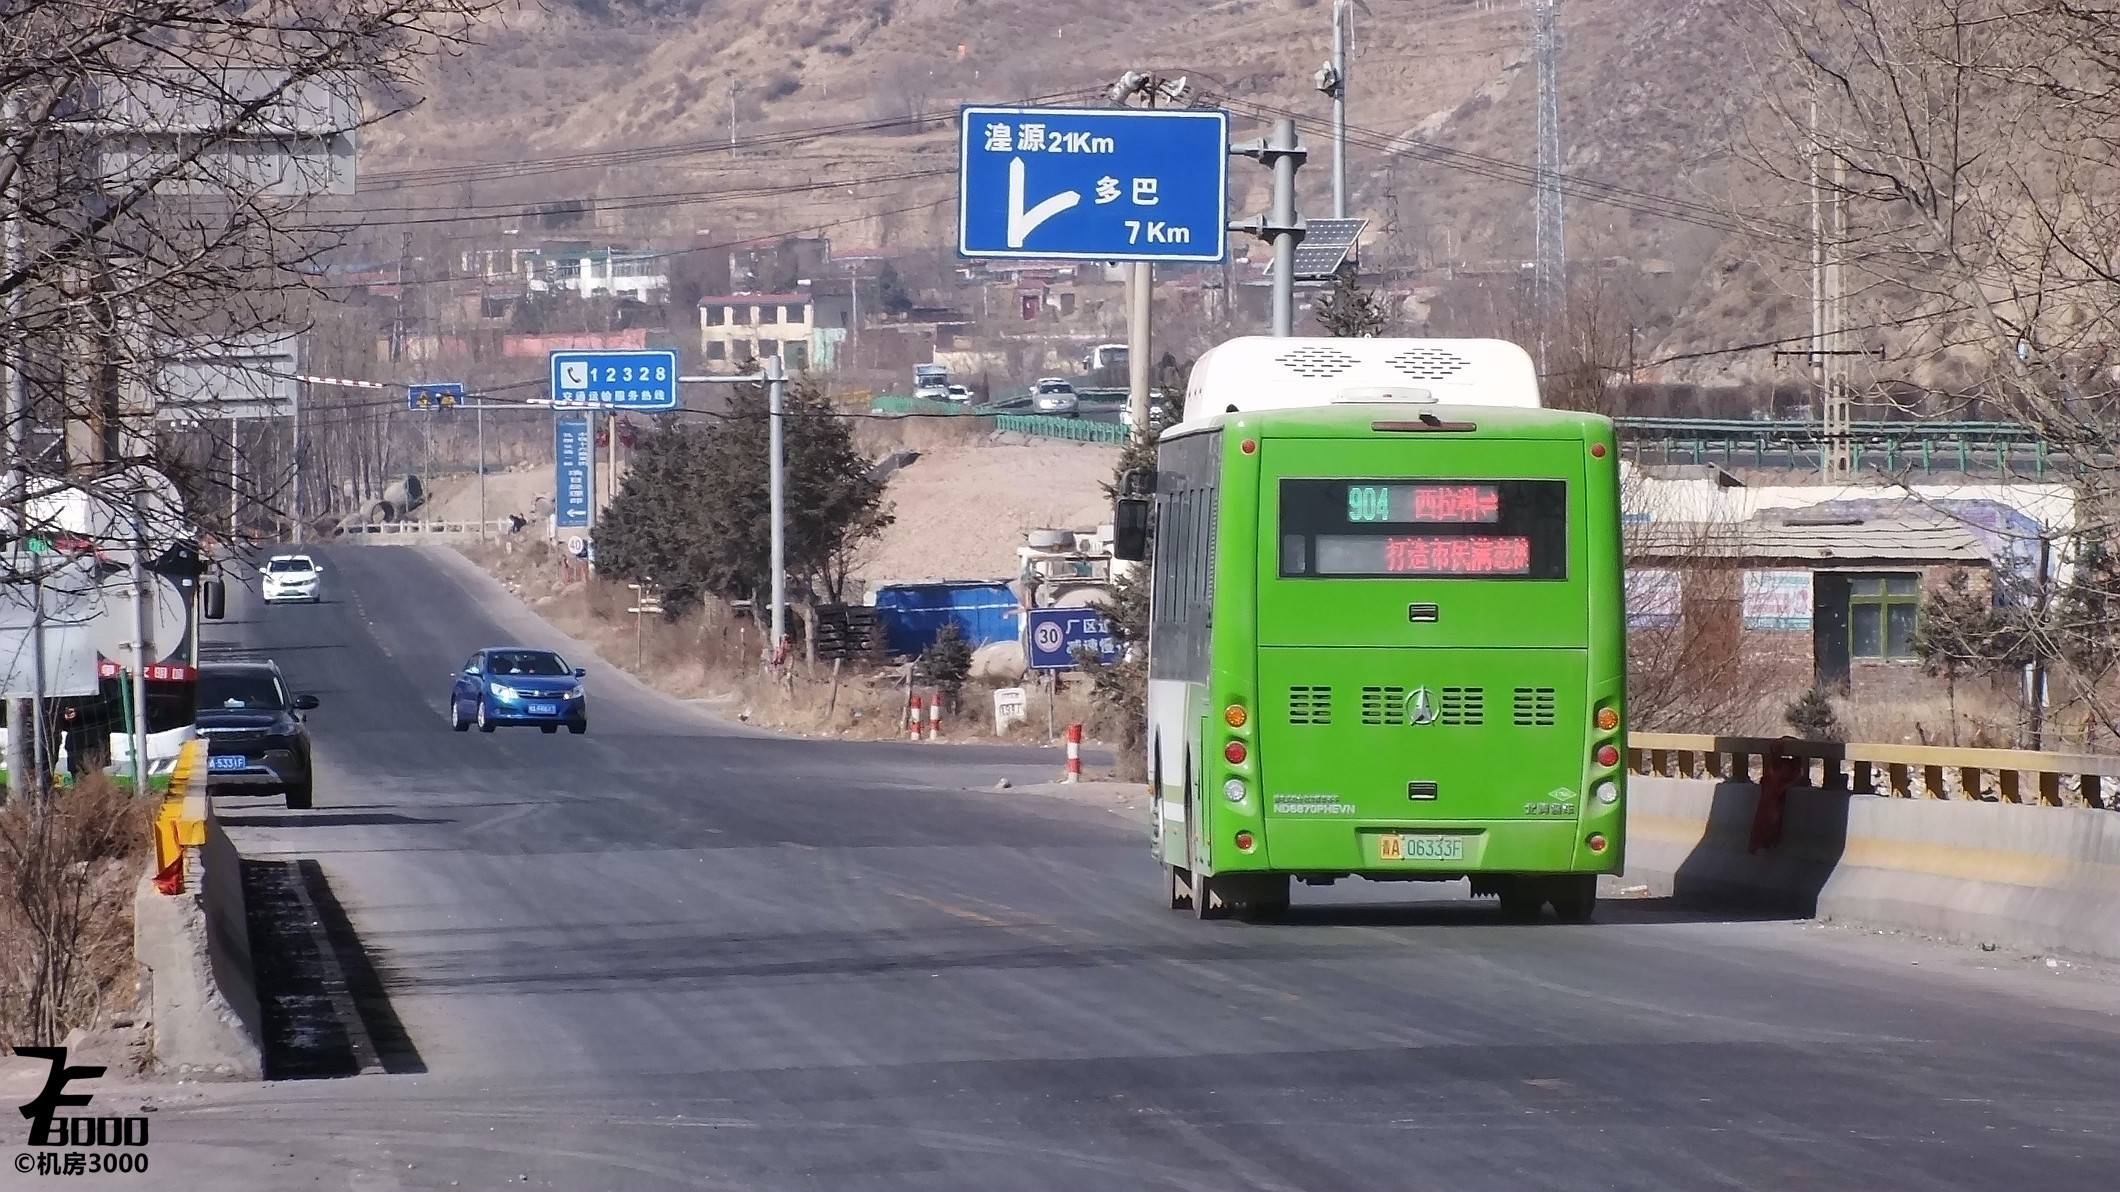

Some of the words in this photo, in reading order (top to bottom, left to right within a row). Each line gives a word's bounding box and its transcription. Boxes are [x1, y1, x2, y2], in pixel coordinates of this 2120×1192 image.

[1095, 175, 1159, 206] 多巴
[590, 367, 666, 382] 12328
[1349, 487, 1389, 521] 904
[1040, 628, 1058, 644] 30
